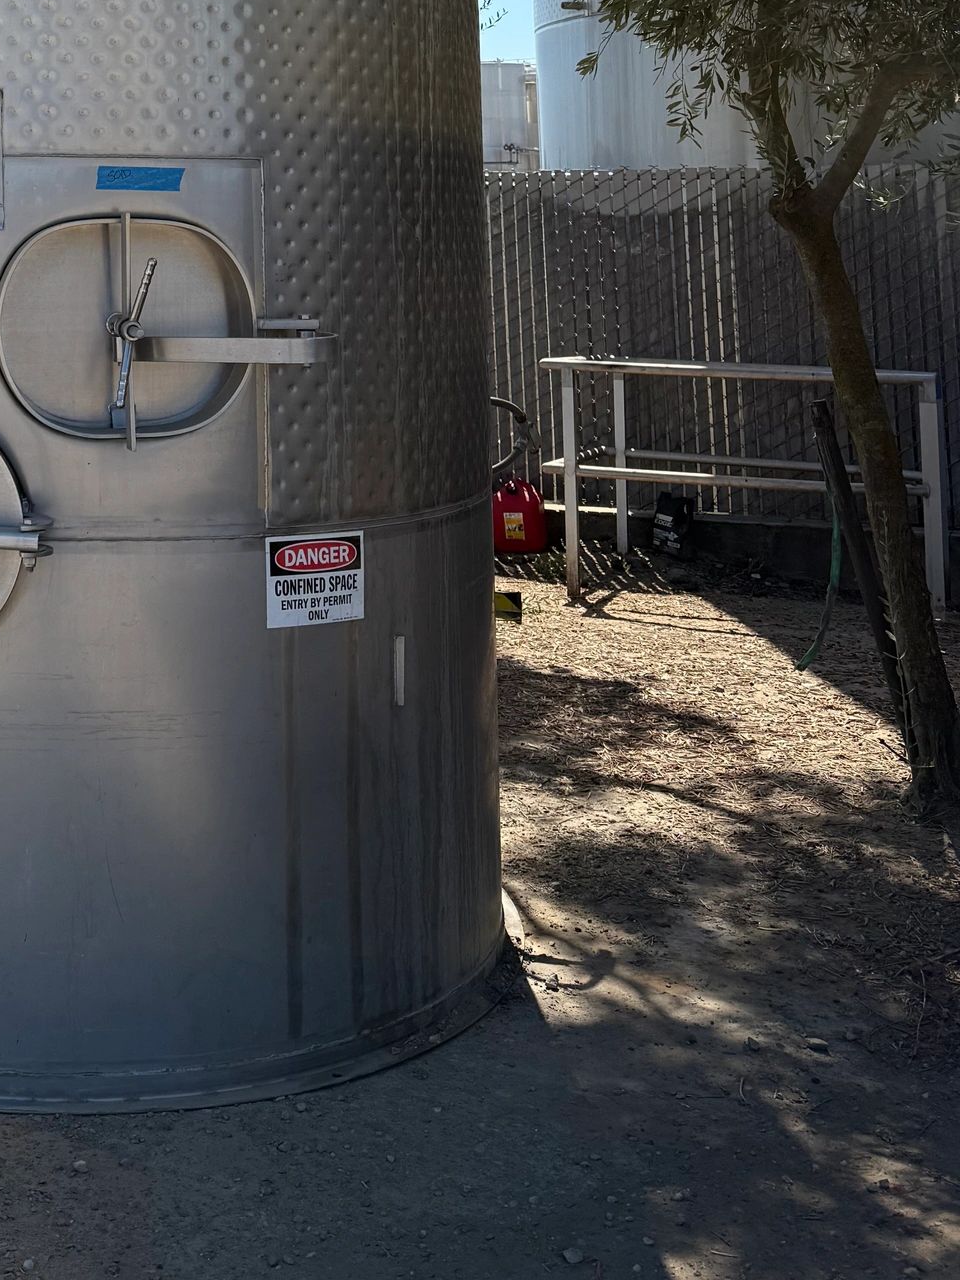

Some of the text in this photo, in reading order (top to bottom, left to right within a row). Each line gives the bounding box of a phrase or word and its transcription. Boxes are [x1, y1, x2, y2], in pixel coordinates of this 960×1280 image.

[284, 545, 350, 567] DANGER
[274, 573, 358, 597] CONFINED SPACE
[281, 593, 353, 611] ENTRY BY PERMIT
[308, 609, 329, 621] ONLY
